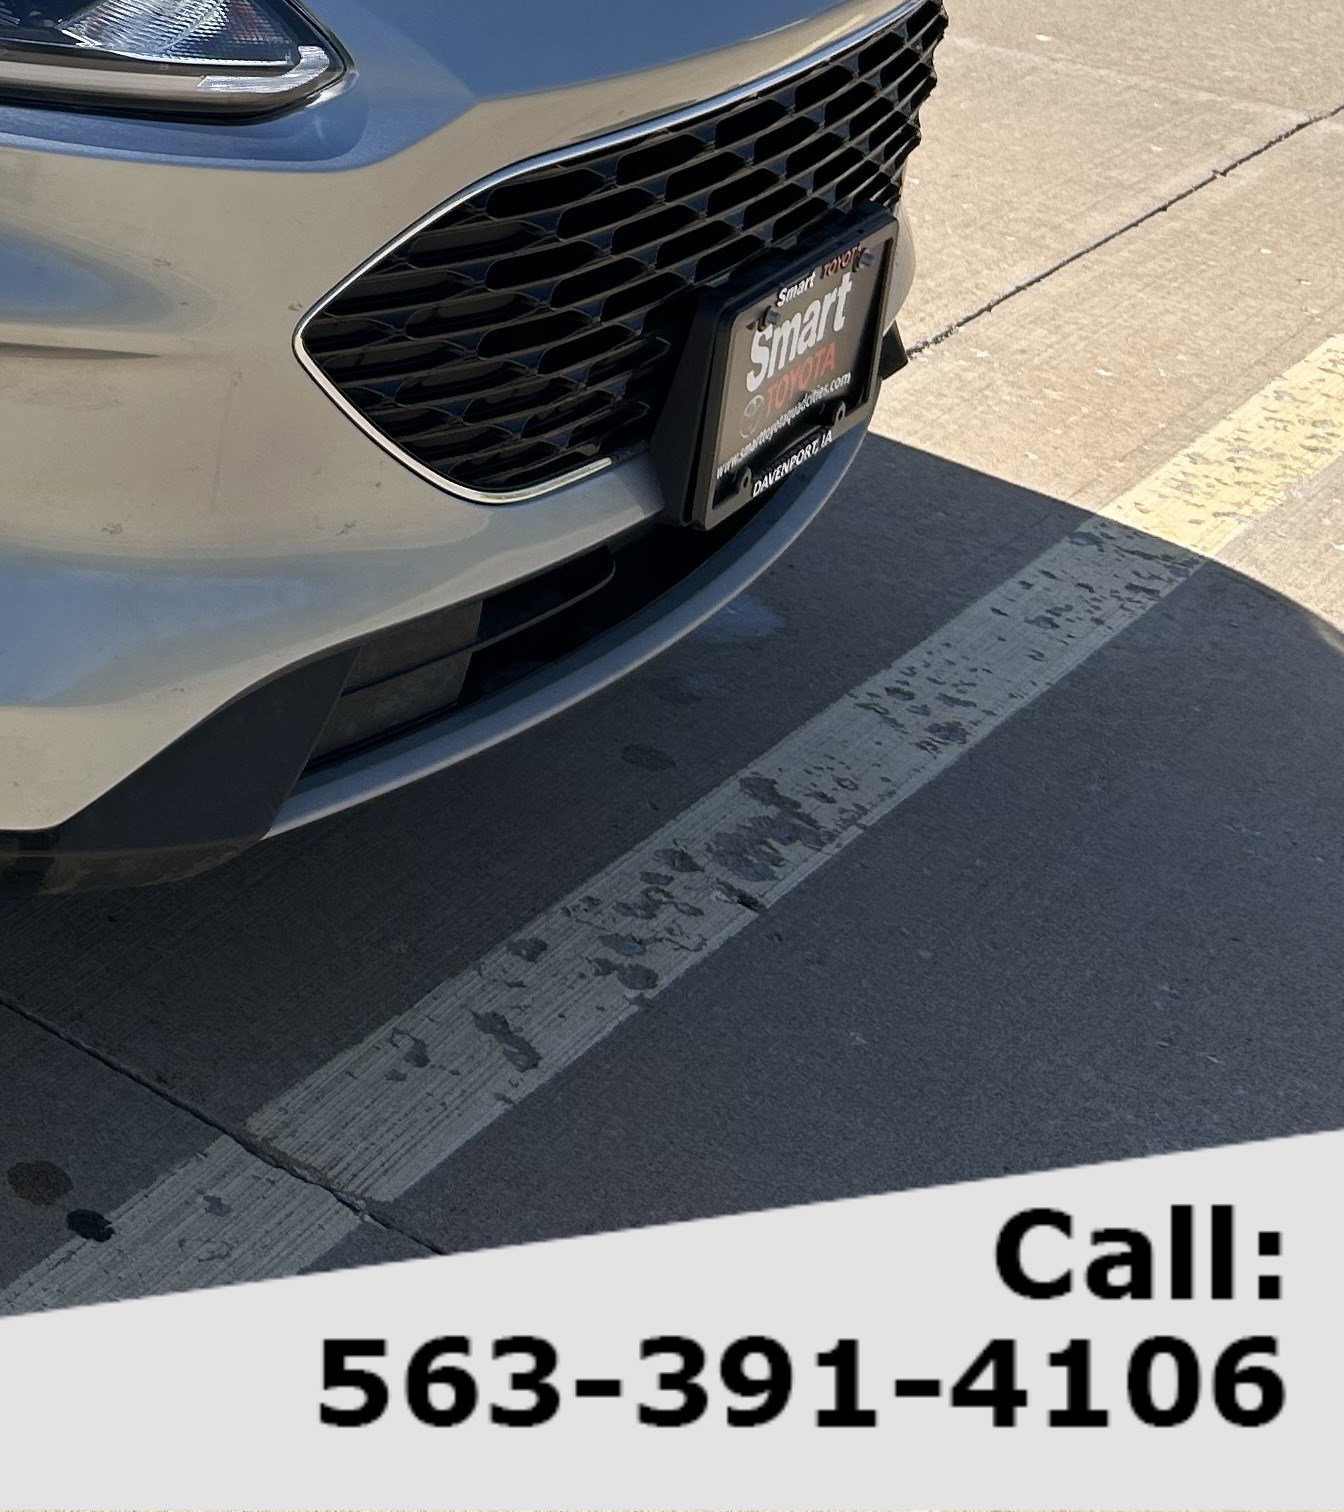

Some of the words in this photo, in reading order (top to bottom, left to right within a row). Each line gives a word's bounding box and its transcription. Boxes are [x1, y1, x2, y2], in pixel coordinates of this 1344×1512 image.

[777, 270, 816, 308] Smart
[821, 244, 864, 278] TOYOT
[746, 272, 853, 392] Smart
[765, 343, 836, 419] TOYOTA
[820, 429, 833, 449] IA
